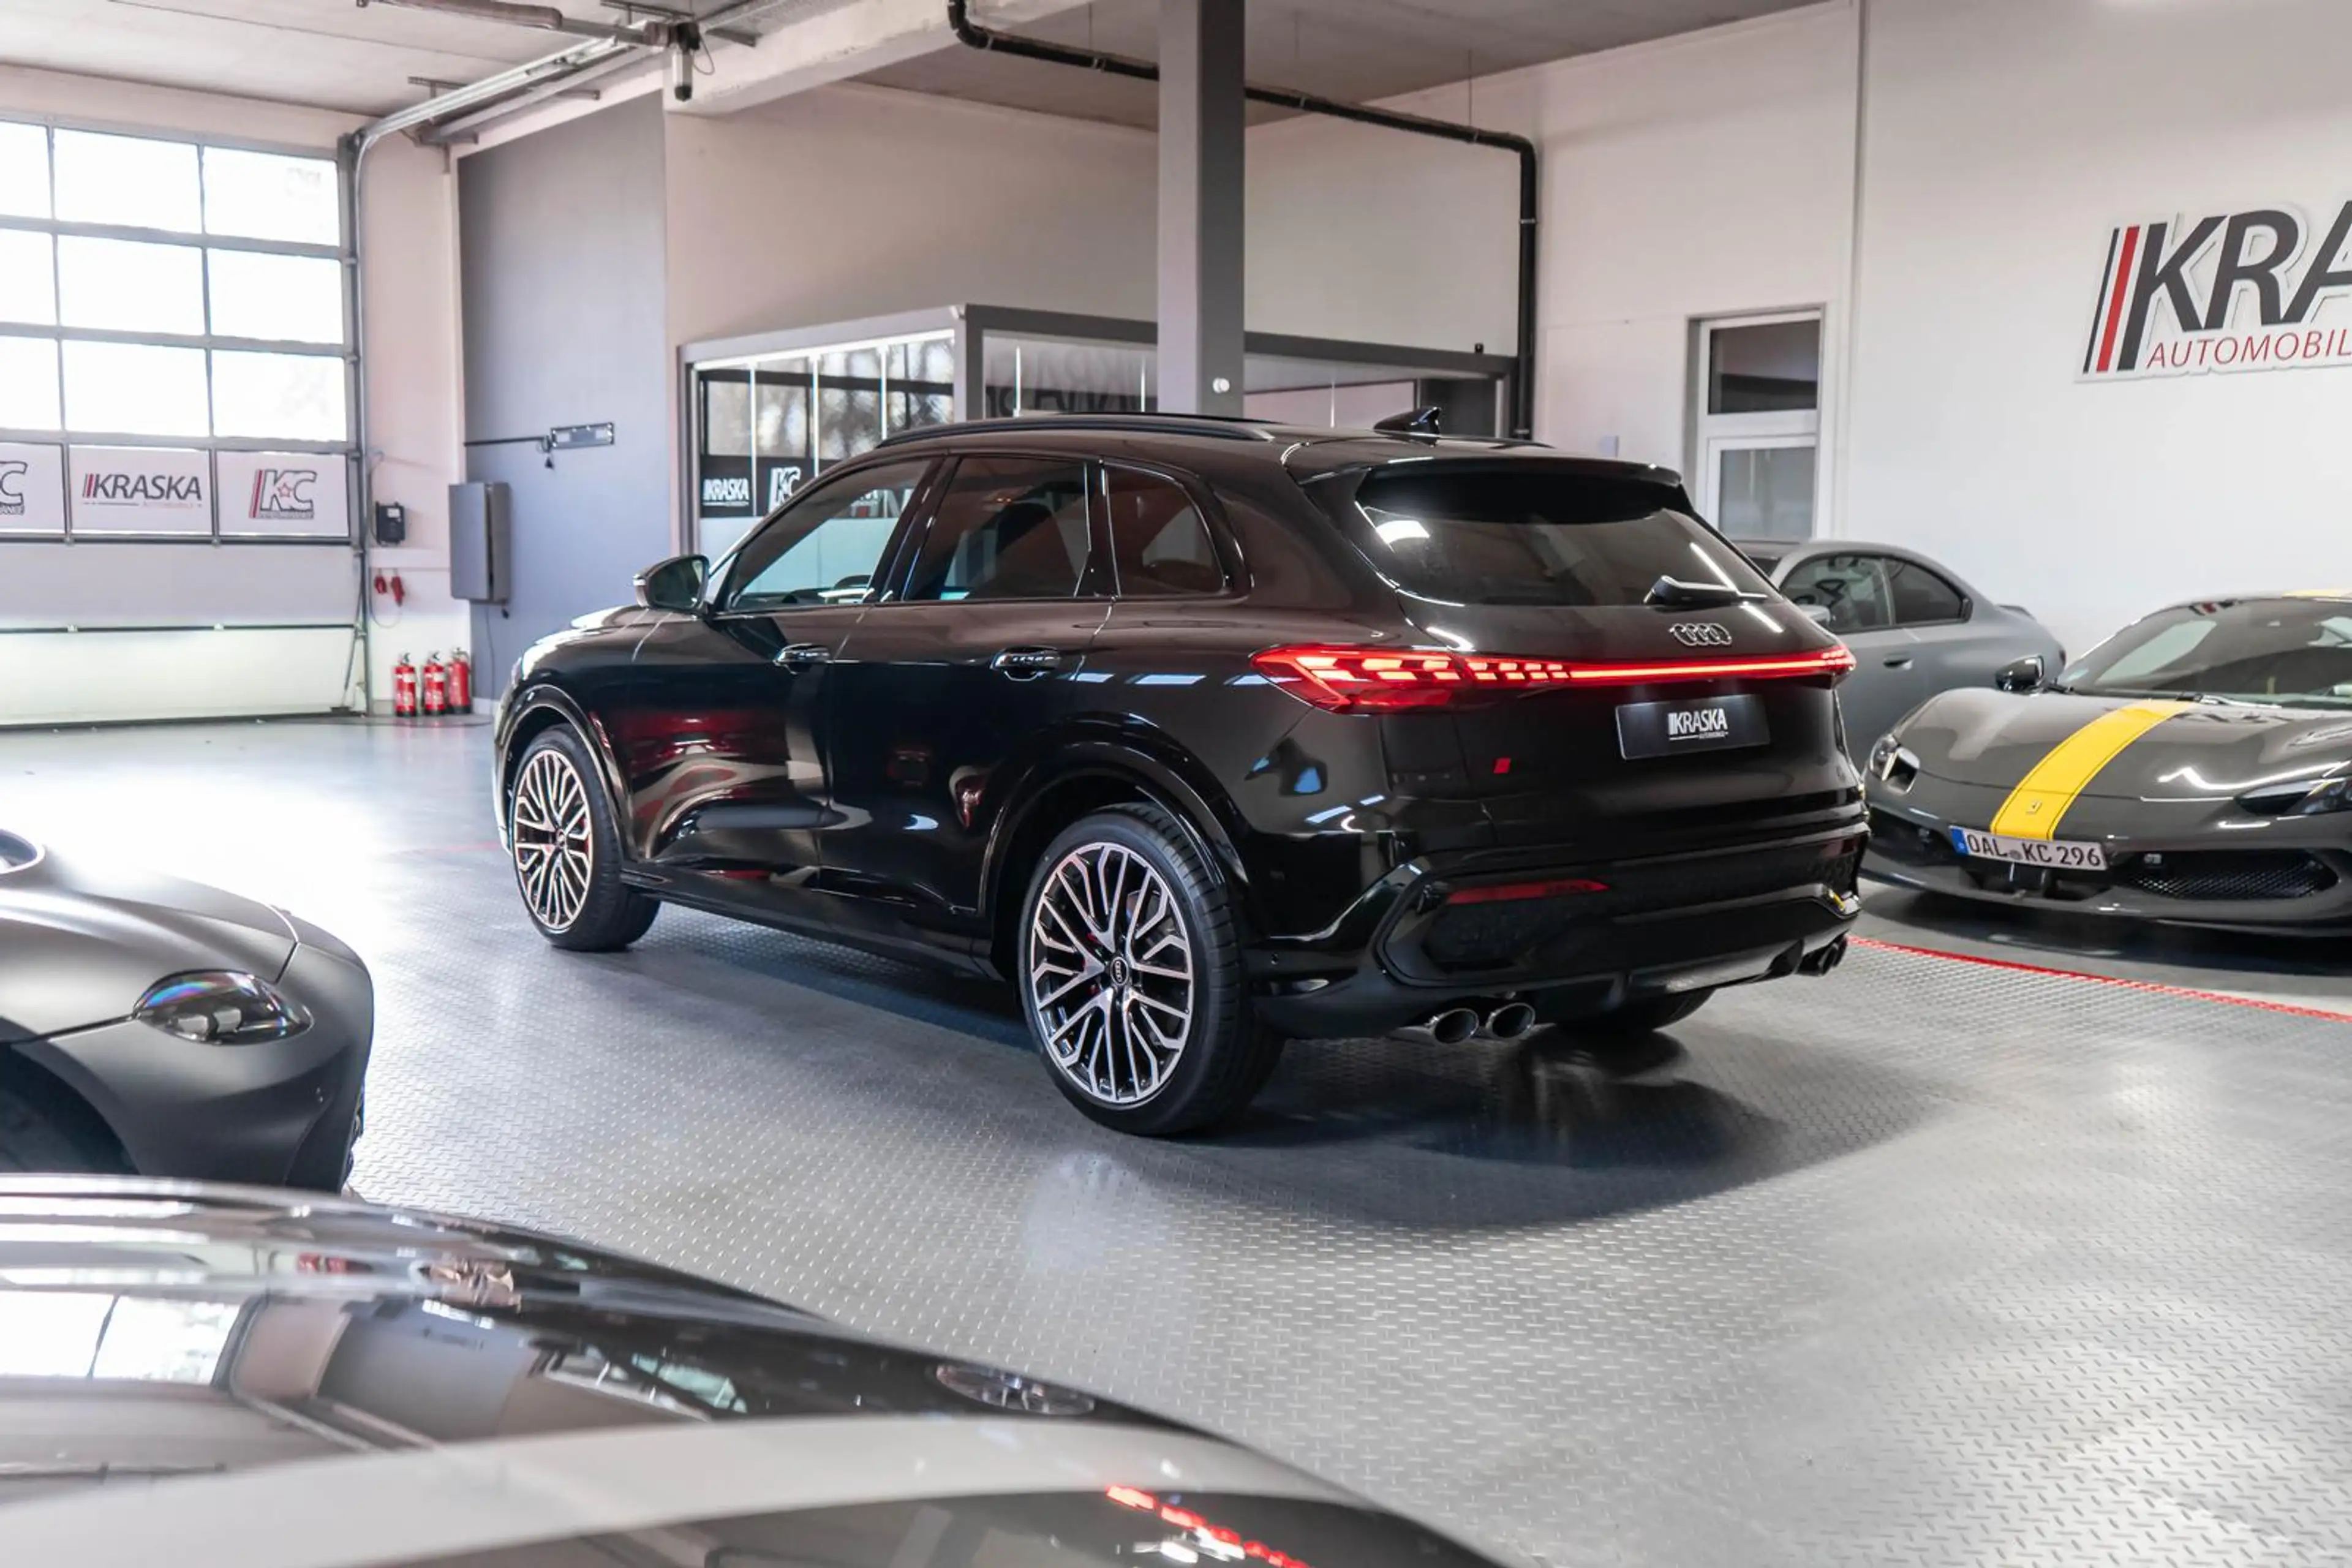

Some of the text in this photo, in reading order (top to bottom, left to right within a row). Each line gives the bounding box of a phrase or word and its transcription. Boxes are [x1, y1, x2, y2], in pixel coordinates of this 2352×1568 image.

[1966, 834, 2101, 866] OAL KC 296
